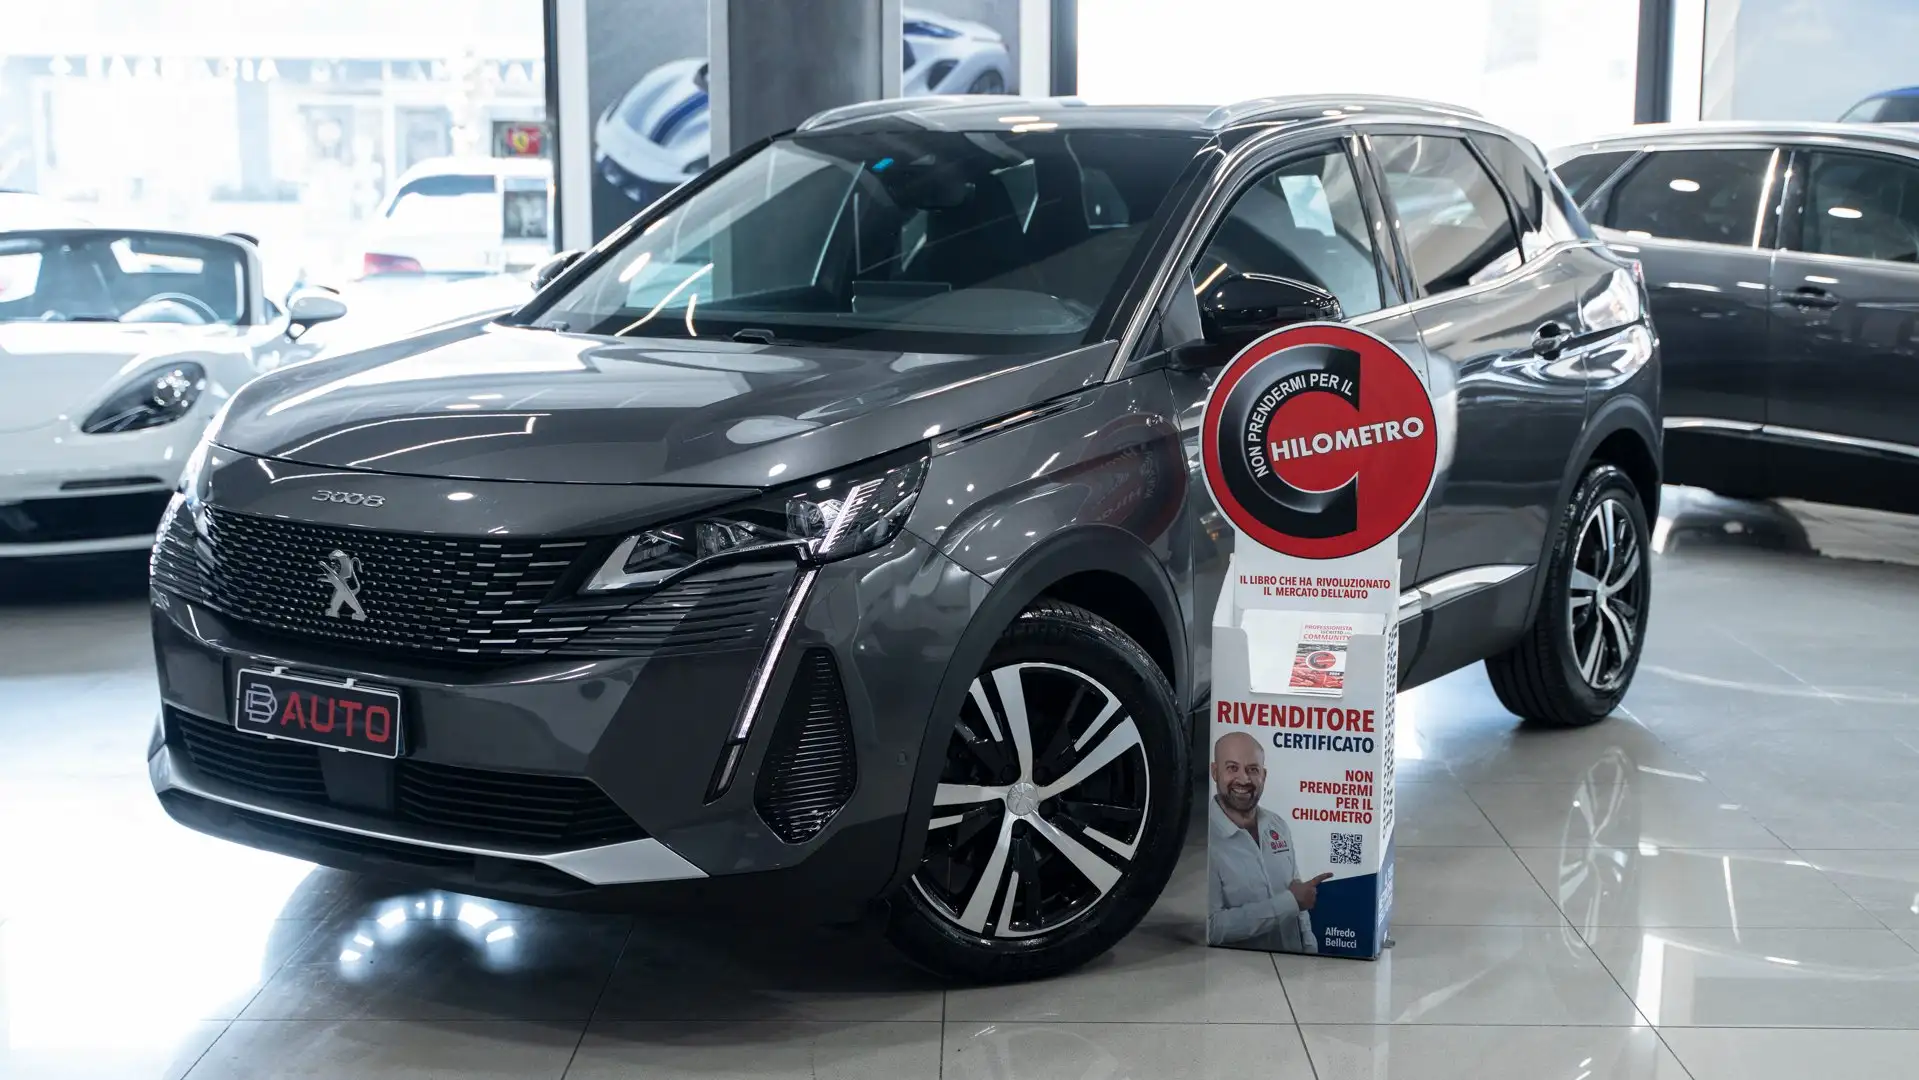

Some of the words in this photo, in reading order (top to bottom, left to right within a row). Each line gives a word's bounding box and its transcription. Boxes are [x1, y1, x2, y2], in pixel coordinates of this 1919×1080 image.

[1310, 373, 1339, 388] PER
[1340, 378, 1353, 397] IL
[1248, 375, 1307, 443] PRENDERMI
[1248, 442, 1269, 478] NON
[312, 490, 386, 507] 3008
[1240, 575, 1248, 585] IL
[1250, 575, 1277, 586] LIBRO
[1279, 576, 1297, 586] CHE
[1299, 577, 1313, 587] HA
[1316, 577, 1391, 589] RIVOLUZIONATO
[1263, 587, 1272, 596] IL
[1275, 587, 1319, 598] MERCATO
[1321, 588, 1369, 599] DELL'AUTO
[280, 691, 390, 743] AUTO
[1217, 700, 1375, 733] RIVENDITORE
[1272, 731, 1375, 754] CERTIFICATO
[1345, 770, 1374, 783] NON
[1299, 780, 1373, 797] PRENDERMI
[1336, 797, 1360, 810] PER
[1362, 798, 1374, 811] IL
[1292, 807, 1373, 825] CHILOMETRO
[1325, 927, 1356, 938] Alfredo
[1325, 937, 1357, 949] Bellucci
